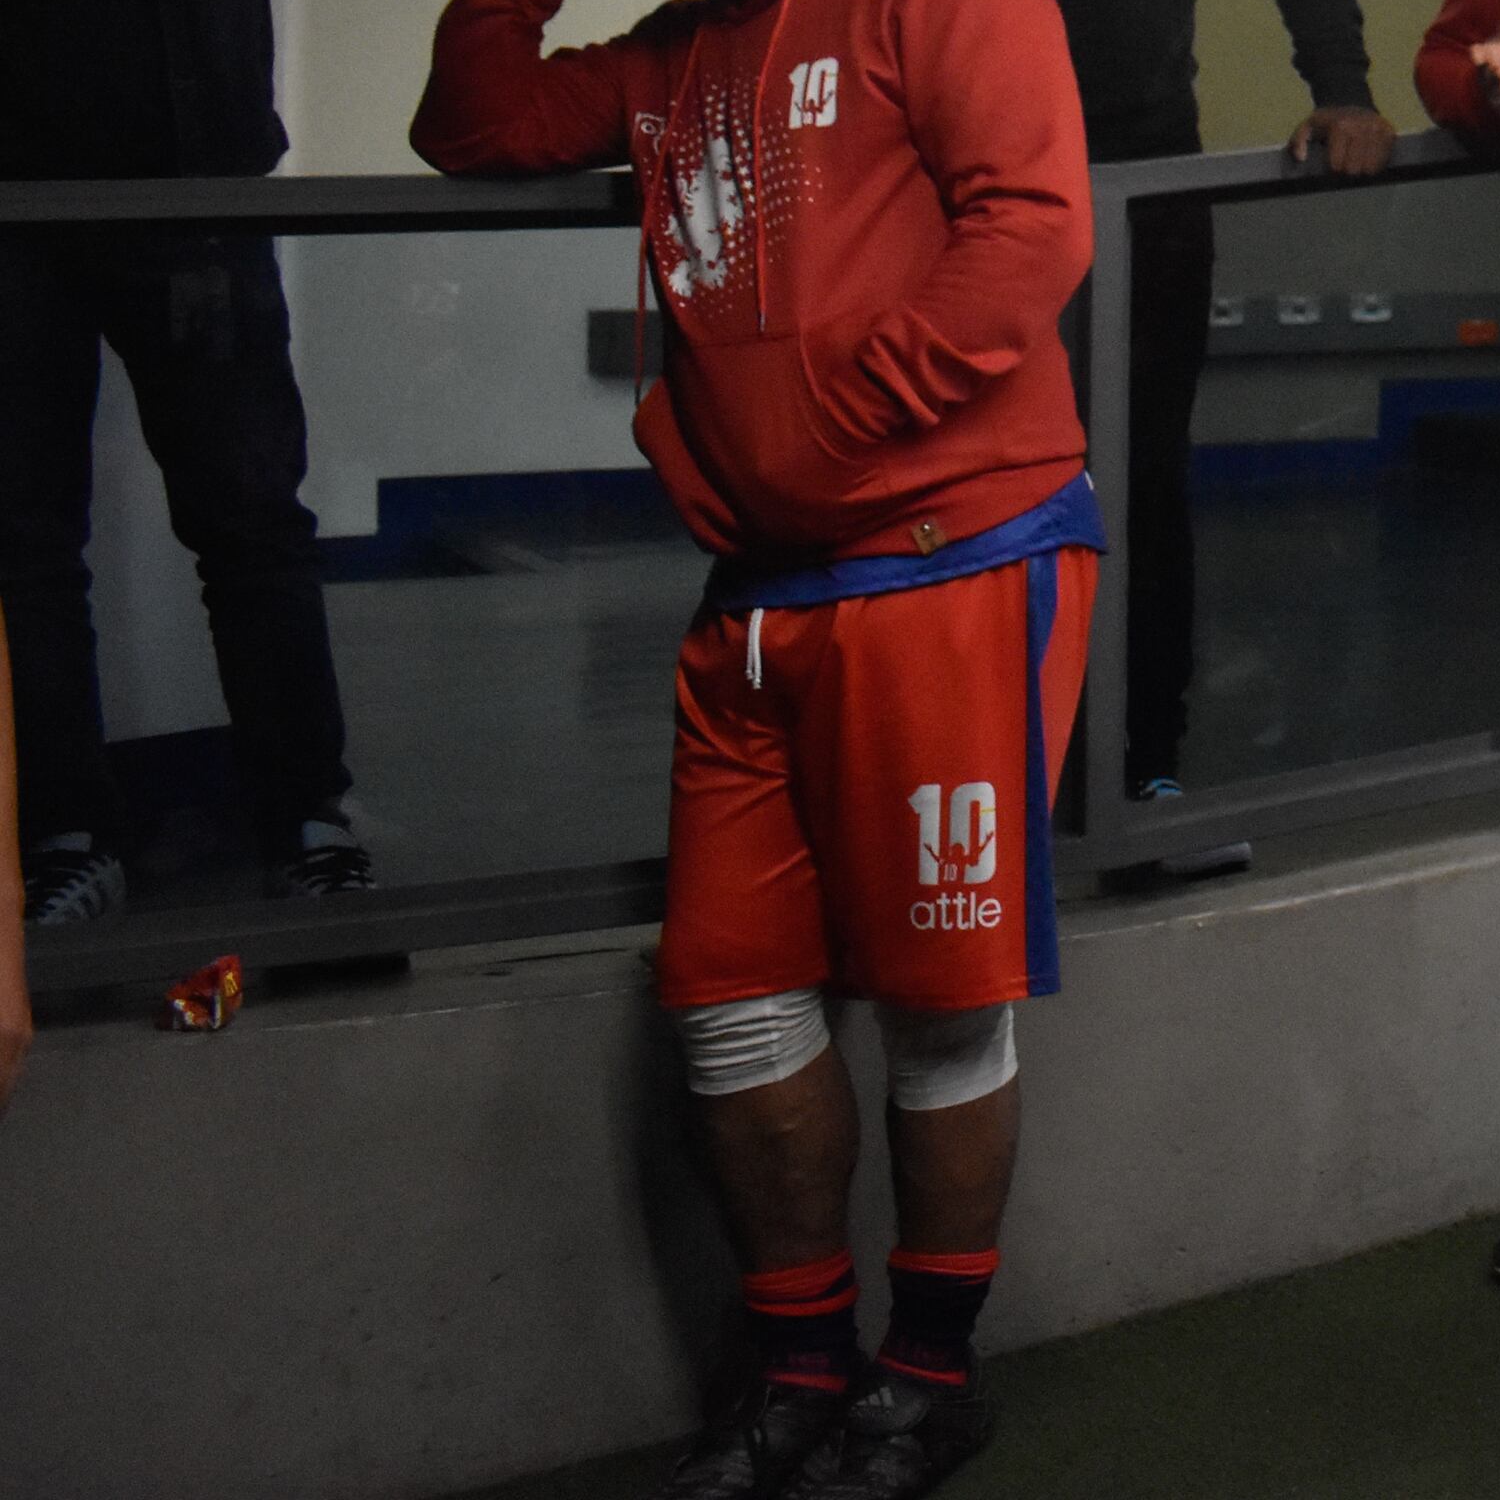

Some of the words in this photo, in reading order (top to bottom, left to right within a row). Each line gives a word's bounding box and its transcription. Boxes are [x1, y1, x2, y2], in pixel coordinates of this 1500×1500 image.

[788, 56, 839, 130] 10
[907, 781, 997, 886] 10
[910, 890, 1003, 931] attle
